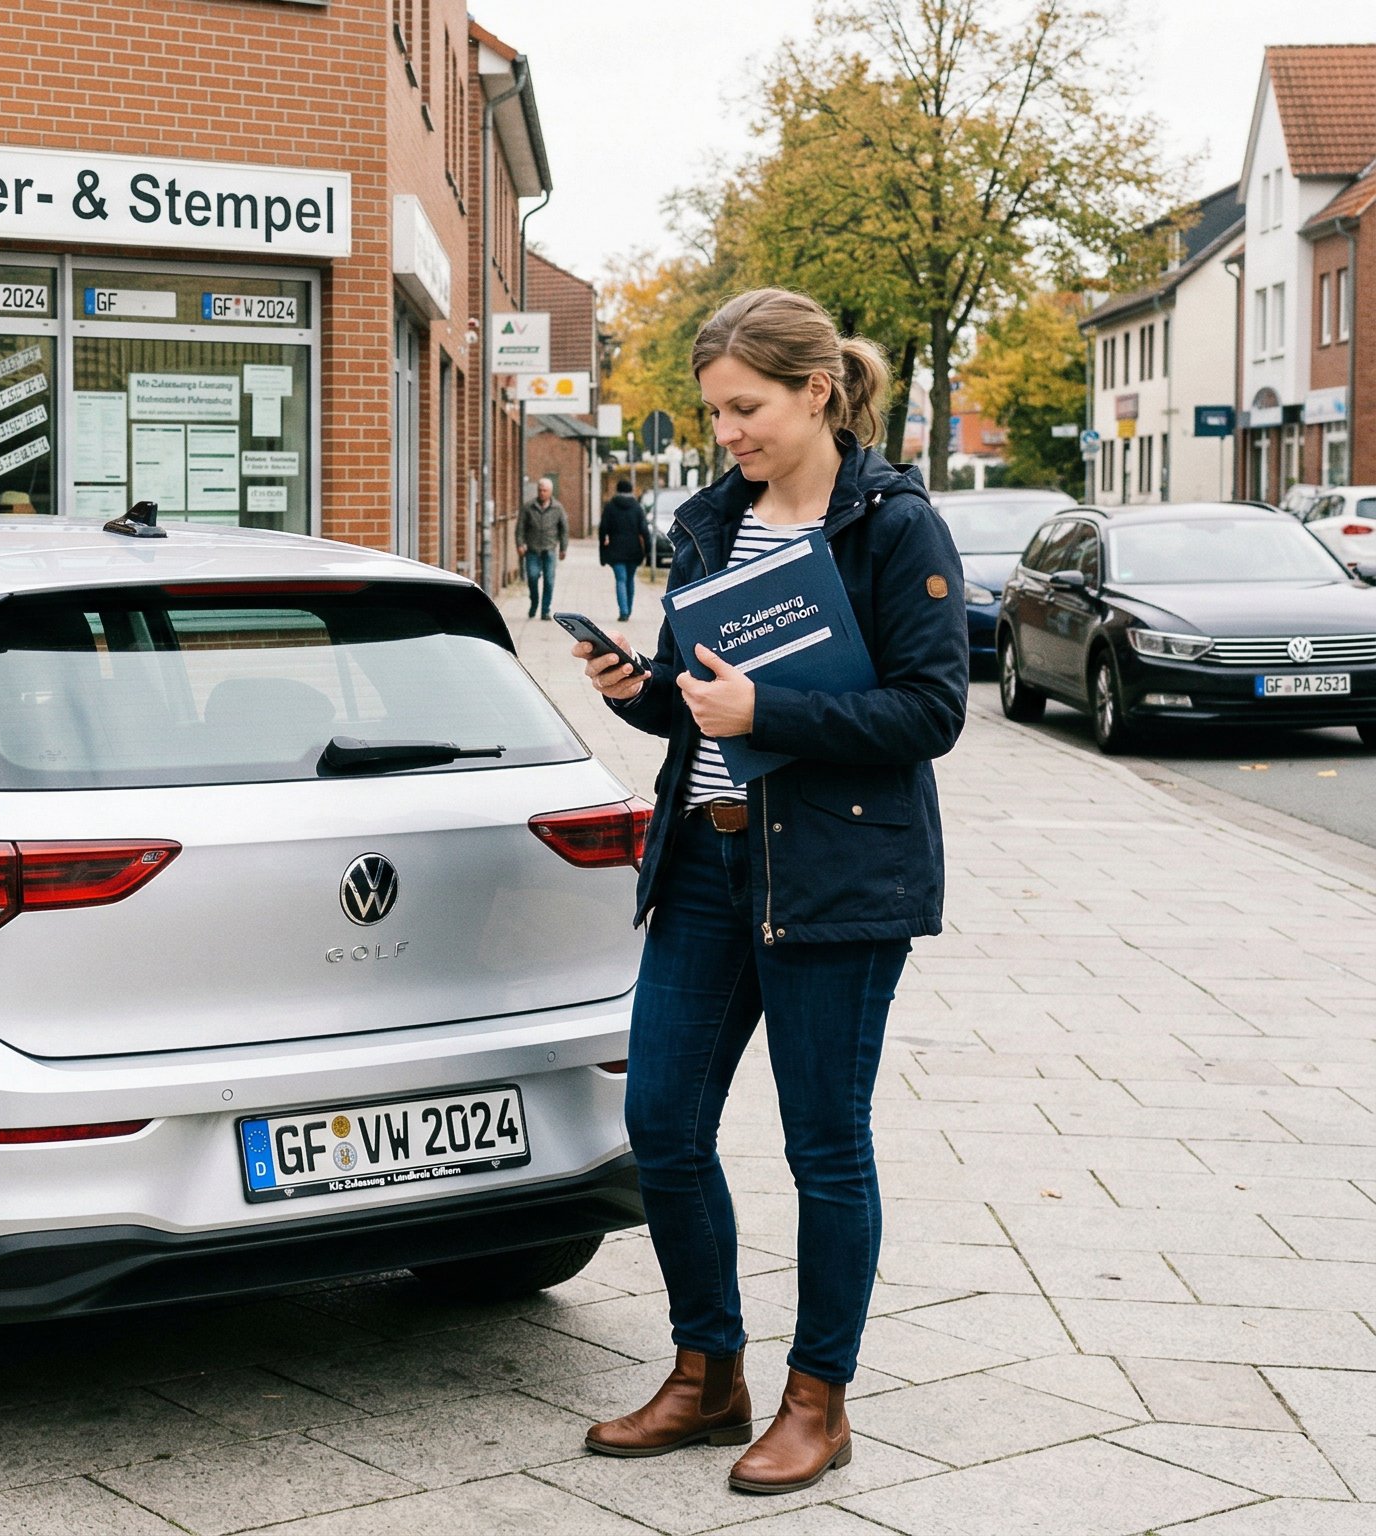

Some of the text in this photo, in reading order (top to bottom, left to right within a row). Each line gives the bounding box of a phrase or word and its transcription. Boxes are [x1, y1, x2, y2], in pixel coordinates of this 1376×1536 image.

[73, 170, 110, 221] &
[129, 174, 334, 244] Stempel
[2, 287, 45, 308] 2024
[97, 292, 117, 312] GF
[213, 297, 232, 316] GF
[257, 299, 295, 319] 2024
[1265, 678, 1283, 693] GF
[1294, 677, 1311, 692] PA
[326, 941, 409, 963] GOLF
[275, 1098, 519, 1175] GF VW 2024
[255, 1162, 266, 1177] D
